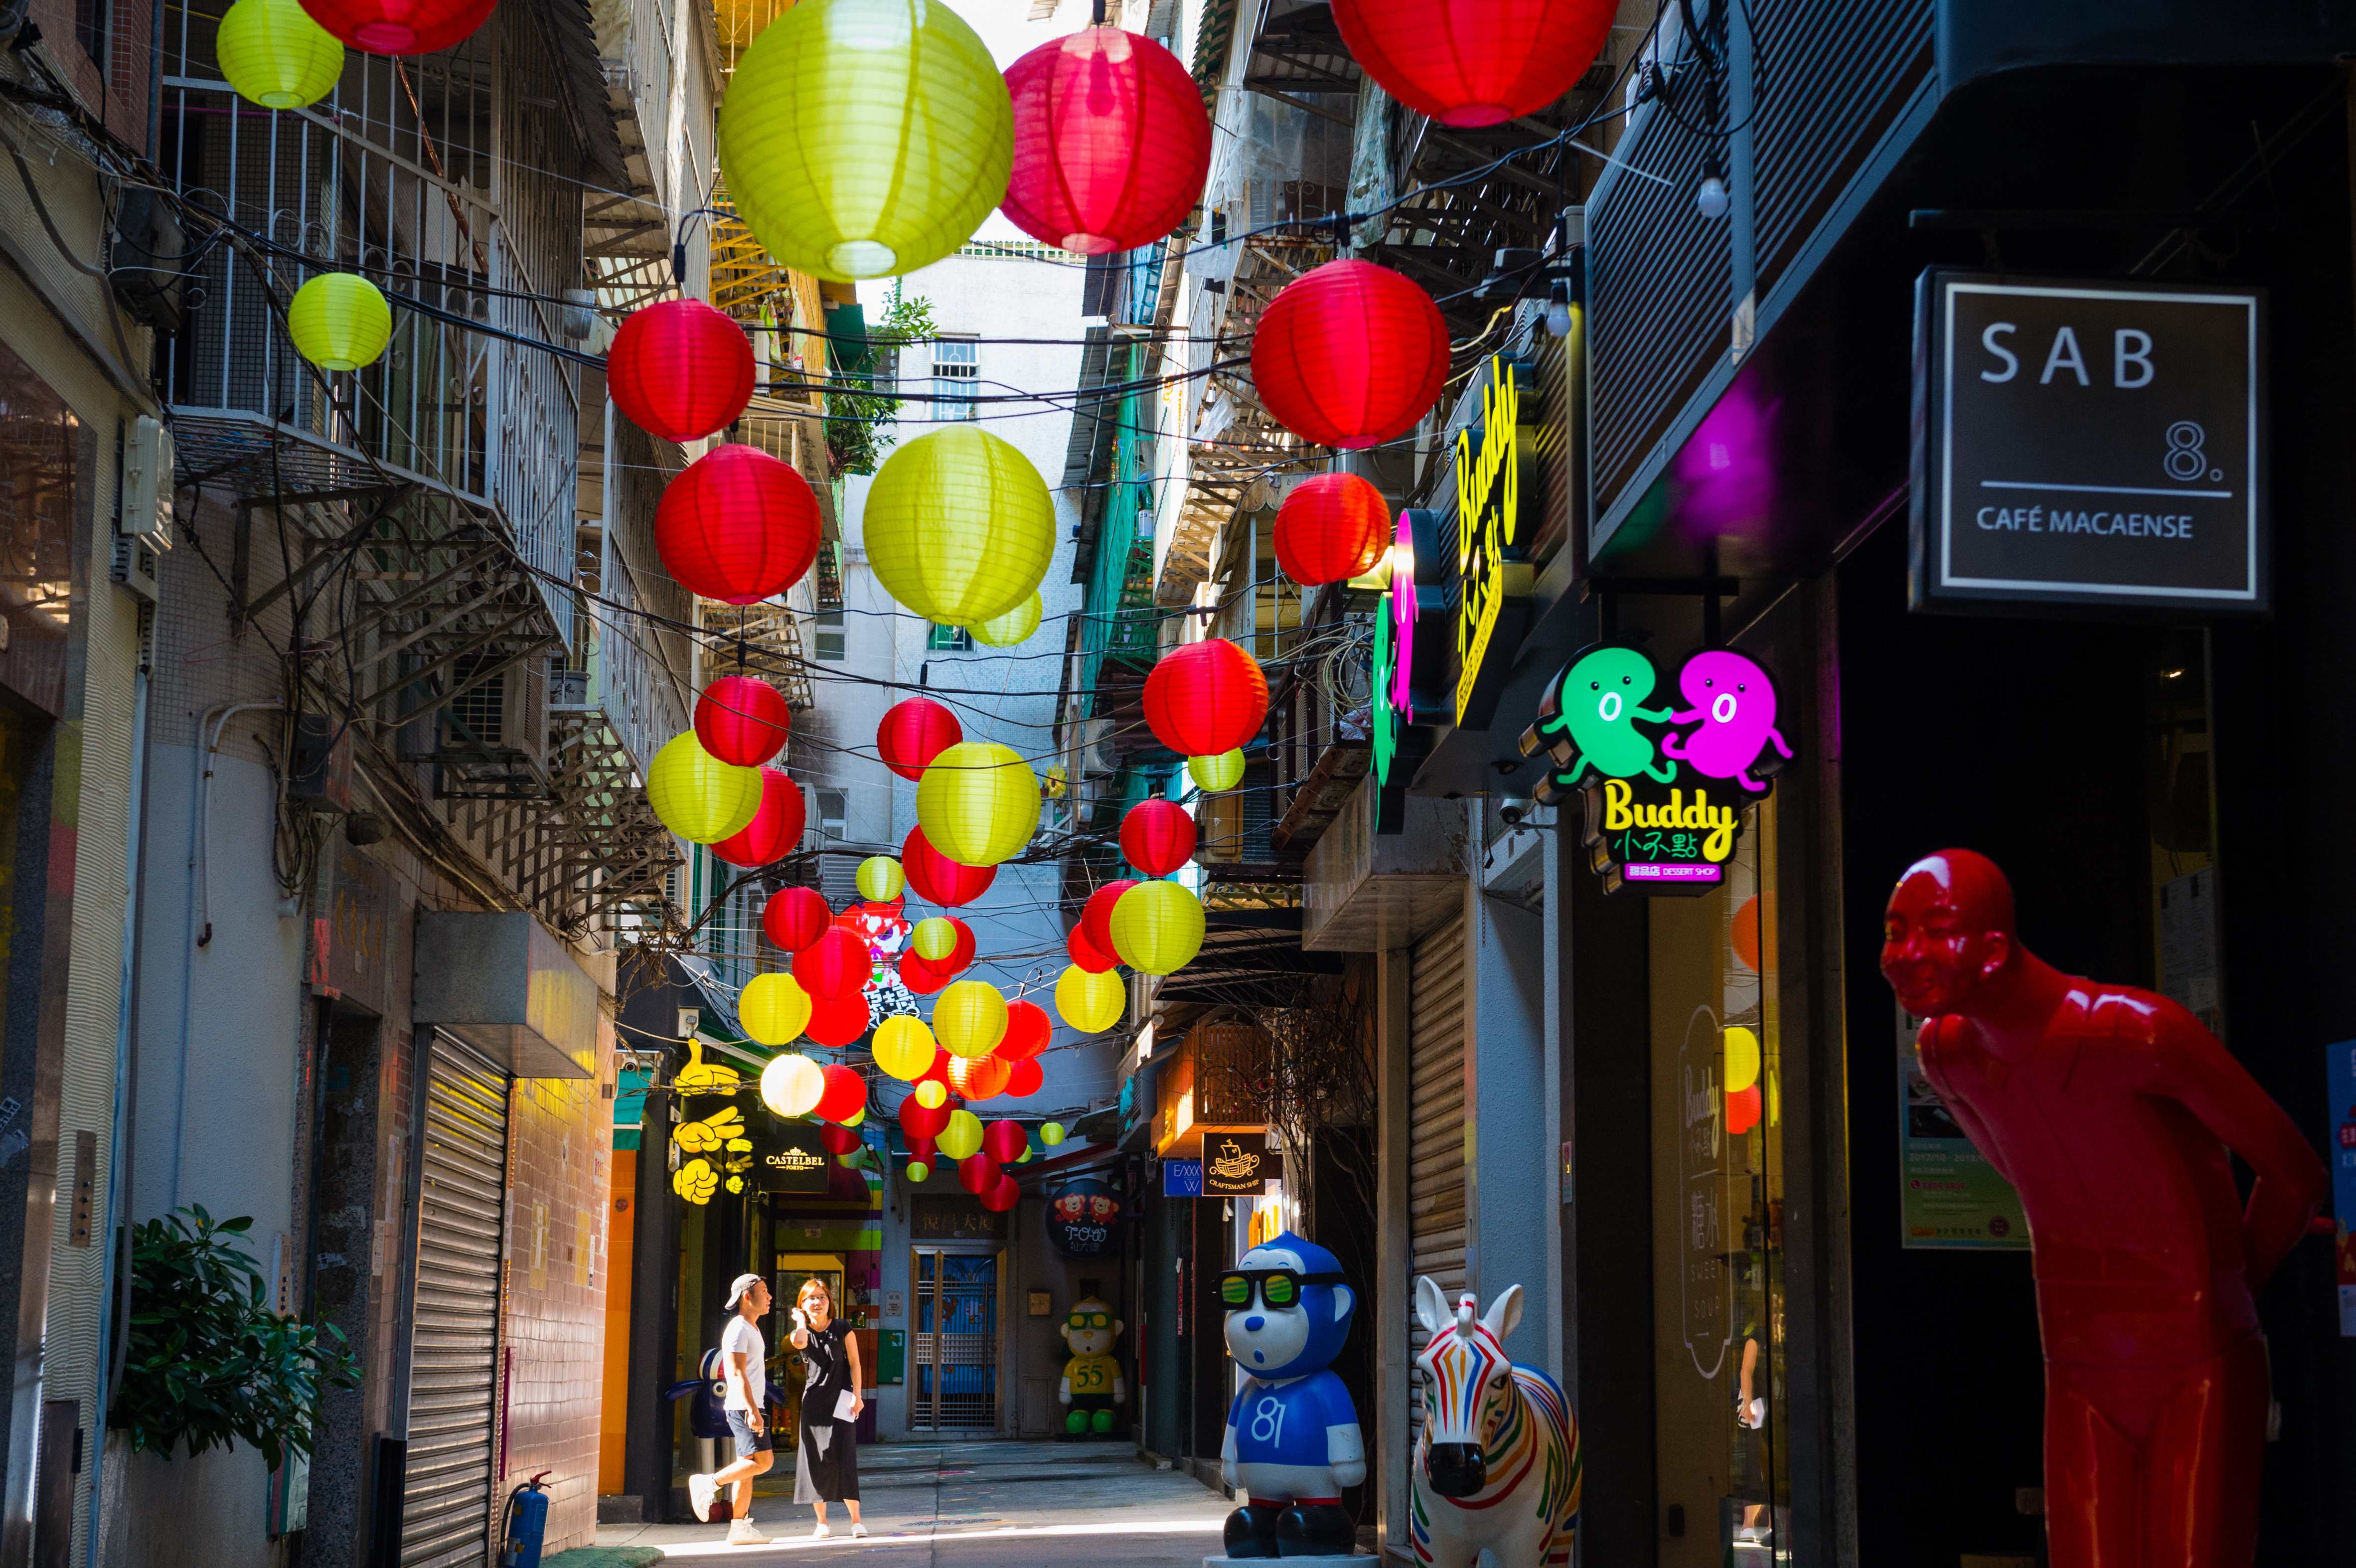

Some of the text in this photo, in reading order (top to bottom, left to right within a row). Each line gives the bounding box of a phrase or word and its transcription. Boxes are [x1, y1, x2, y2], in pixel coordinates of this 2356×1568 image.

[1981, 322, 2154, 388] SAB
[1456, 355, 1518, 575] Buddy
[1977, 505, 2193, 538] CAFÉ MACAENSE
[1604, 779, 1738, 862] Buddy
[1629, 866, 1661, 876] 甜品店
[1685, 1065, 1720, 1159] Buddy
[766, 1156, 824, 1166] CASTELBEL
[1209, 1179, 1259, 1190] CRAFTSMAN SHIP
[1691, 1186, 1720, 1251] 糖水
[1695, 1296, 1720, 1318] SOUP
[1076, 1364, 1103, 1388] 55
